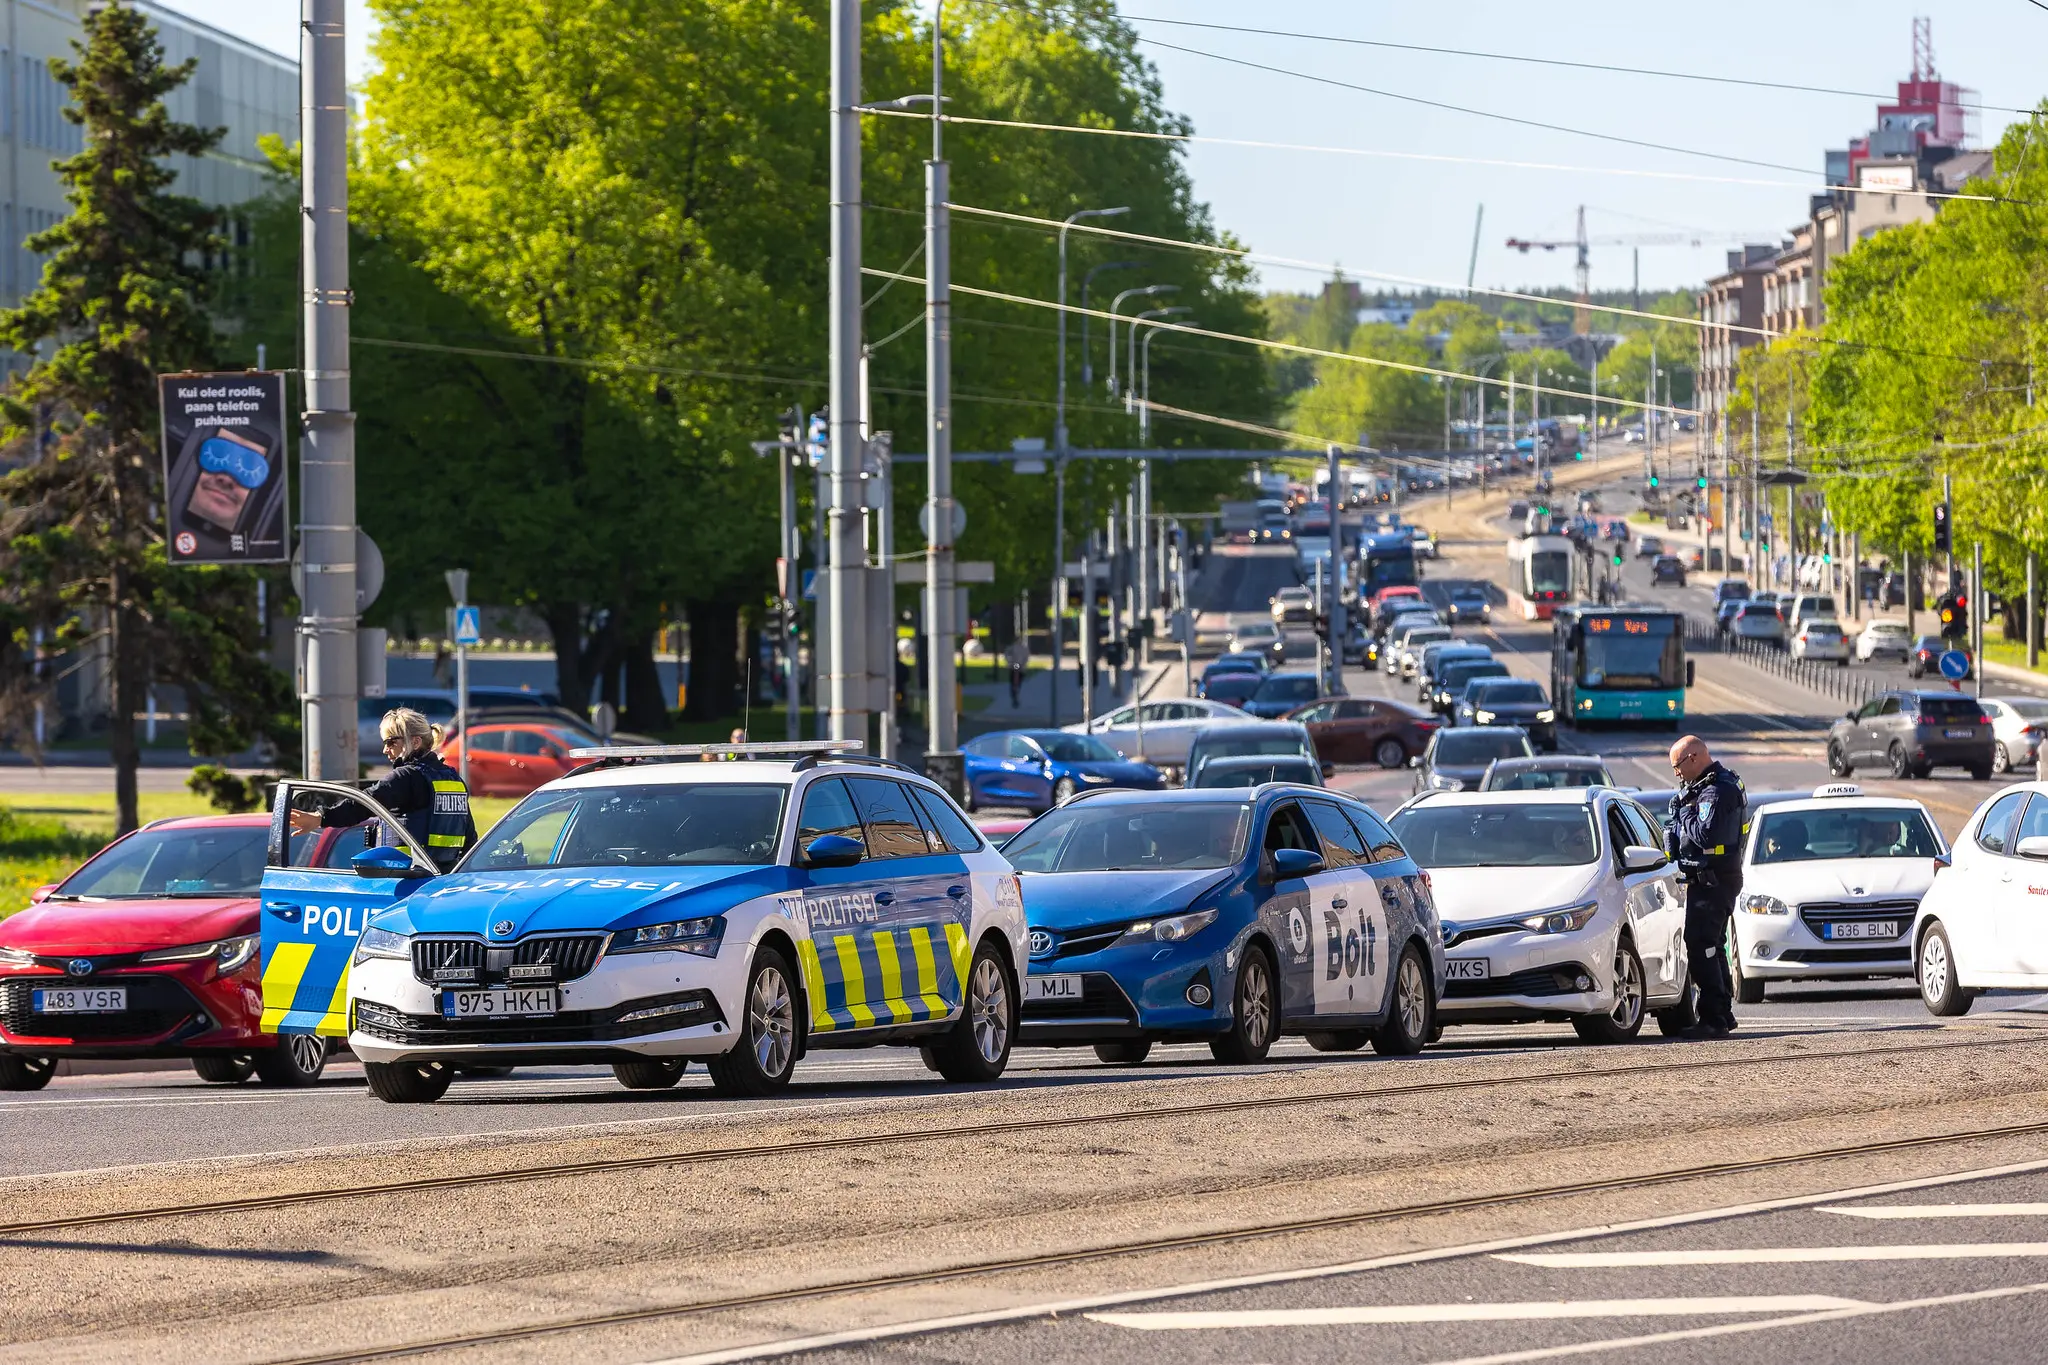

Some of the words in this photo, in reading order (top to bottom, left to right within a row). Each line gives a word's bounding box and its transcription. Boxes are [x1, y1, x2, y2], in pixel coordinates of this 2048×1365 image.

[178, 387, 198, 398] Kui
[200, 387, 226, 398] oled
[228, 386, 266, 398] roolis,
[185, 402, 215, 414] pane
[216, 401, 259, 411] telefon
[195, 415, 250, 428] puhkama
[429, 878, 683, 898] POLITSEI
[808, 892, 879, 927] POLITSEI
[1837, 924, 1860, 937] 636
[1867, 923, 1894, 936] BLN
[1323, 908, 1376, 981] Bolt
[1445, 961, 1484, 978] WKS
[1042, 979, 1076, 997] MJL
[47, 992, 75, 1008] 483
[82, 991, 121, 1008] VSR
[459, 993, 494, 1013] 975
[503, 990, 551, 1012] HKH
